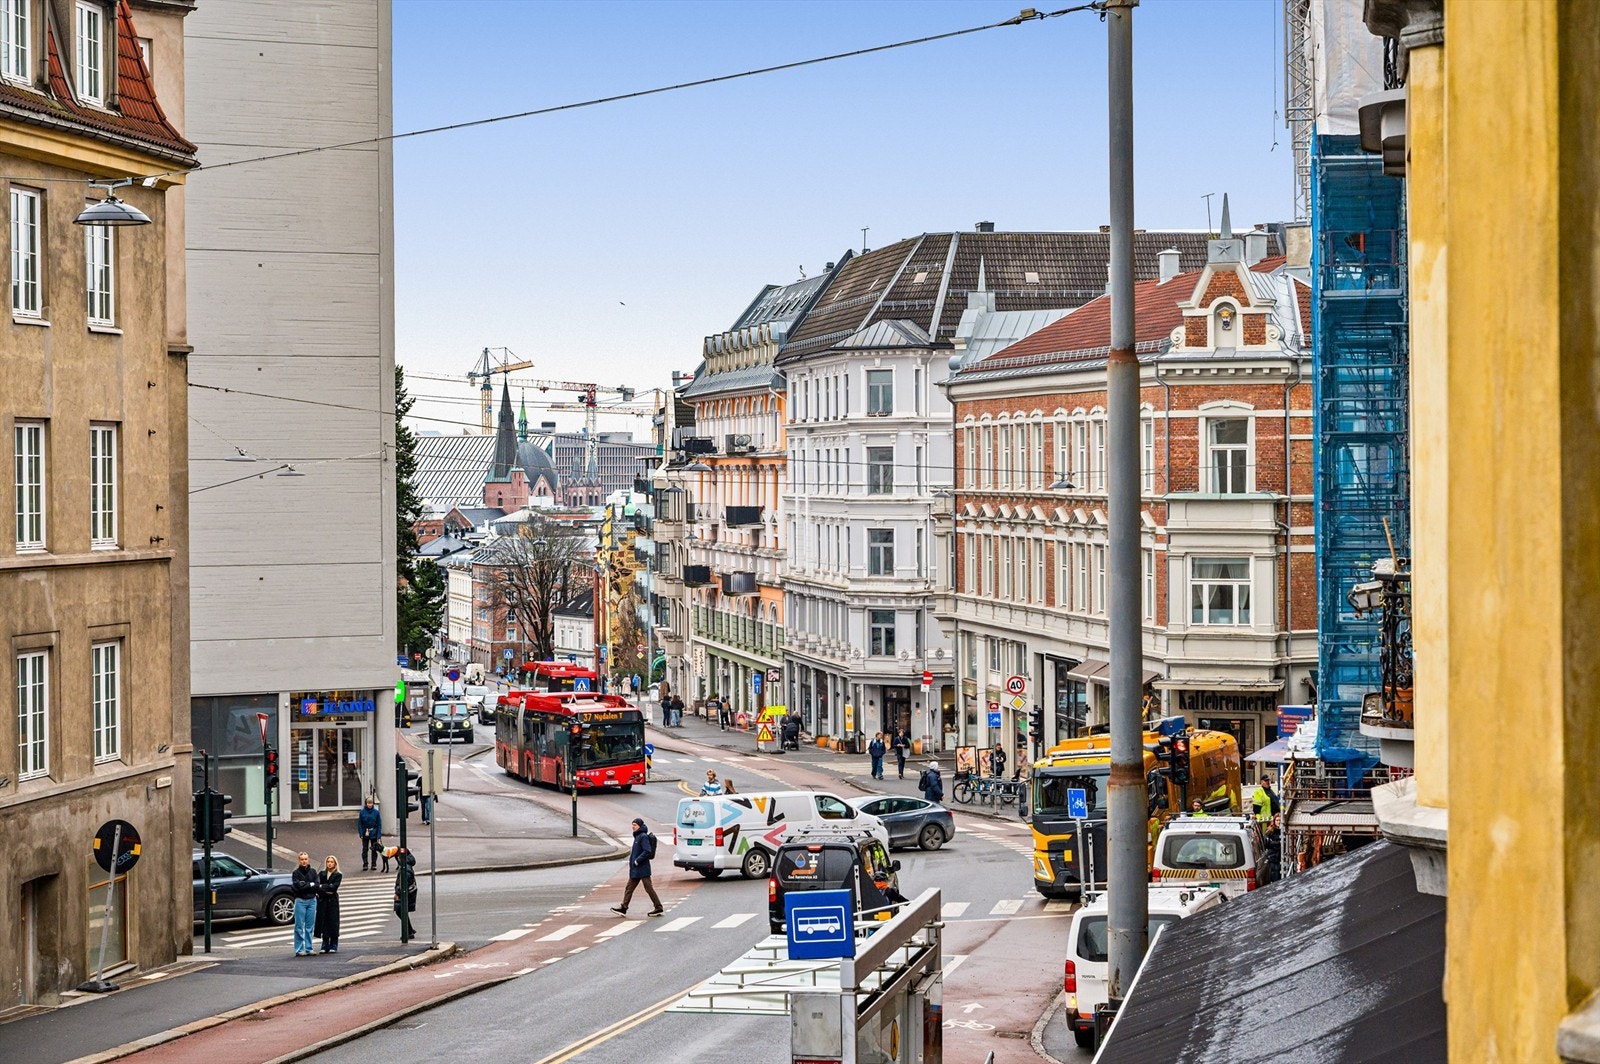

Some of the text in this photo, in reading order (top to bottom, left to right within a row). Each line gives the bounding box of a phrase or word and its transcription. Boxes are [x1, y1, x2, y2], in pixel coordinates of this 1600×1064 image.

[1010, 680, 1023, 690] 40
[1179, 690, 1277, 712] Kaffebrenneriet
[583, 713, 592, 722] 37
[594, 712, 618, 722] Nydalen
